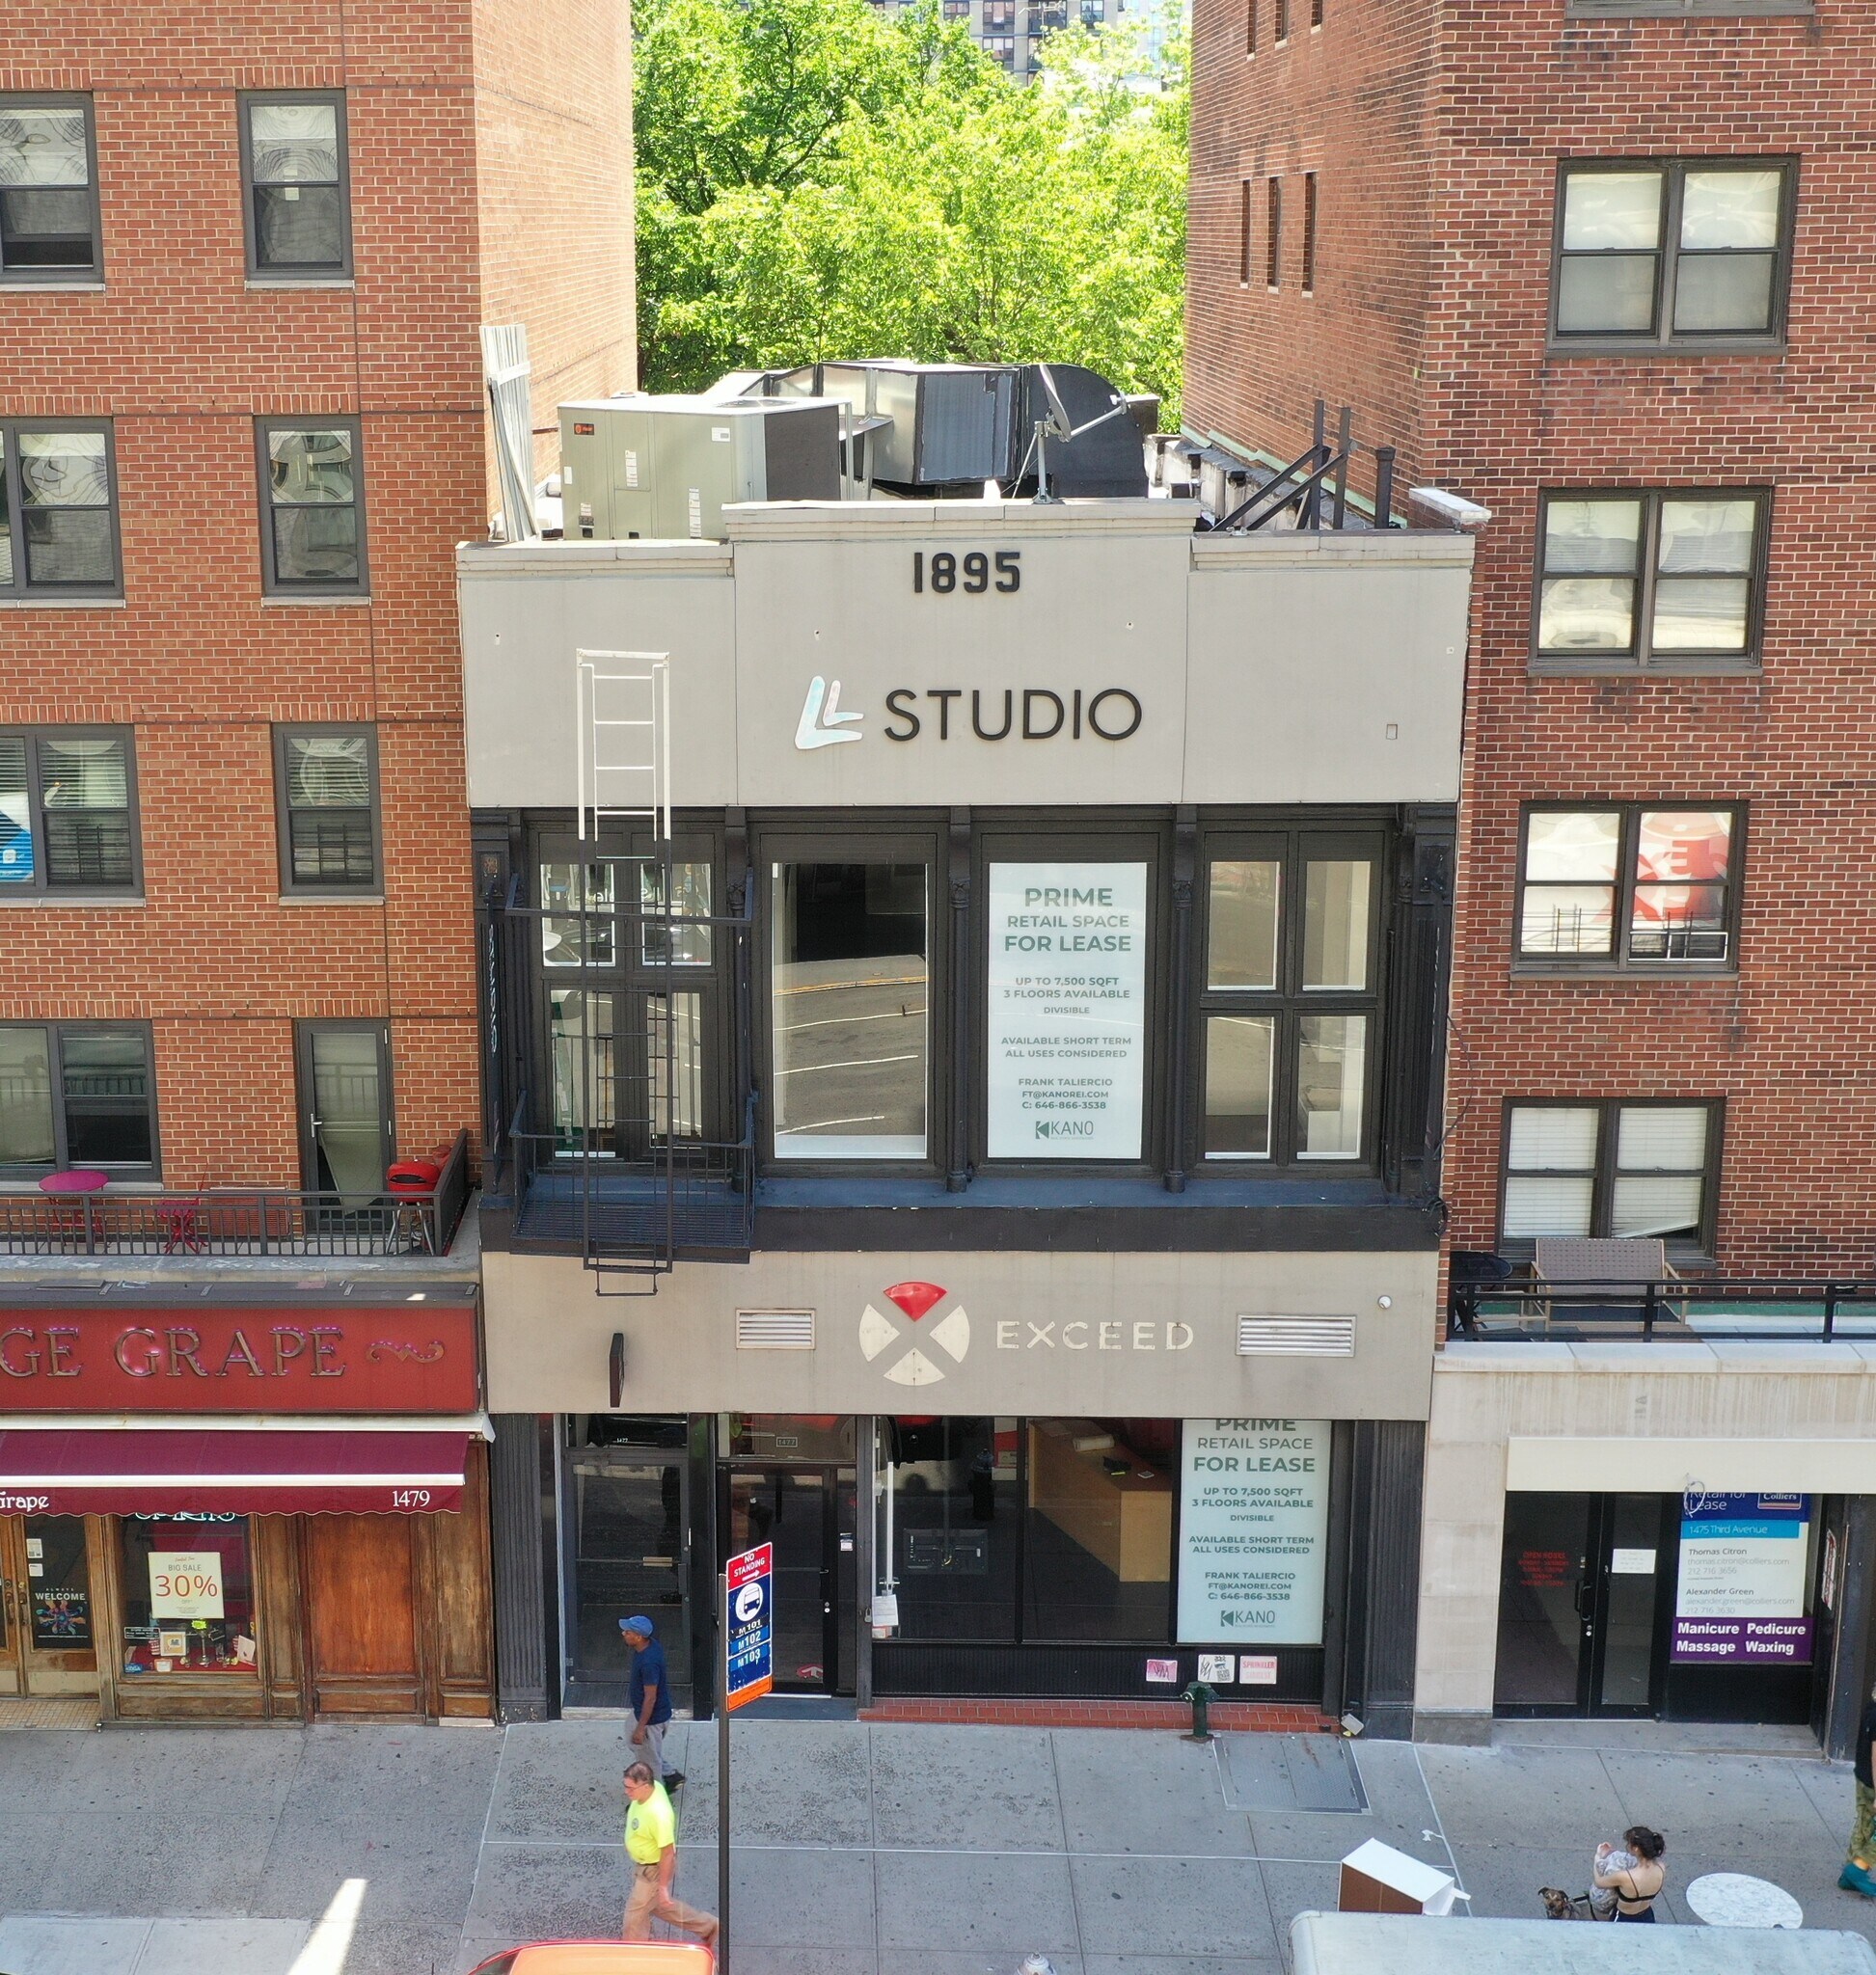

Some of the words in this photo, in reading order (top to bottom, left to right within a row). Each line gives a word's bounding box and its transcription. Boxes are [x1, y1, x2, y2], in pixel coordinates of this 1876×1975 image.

[913, 552, 1021, 593] 1895
[884, 688, 1142, 742] STUDIO
[1024, 887, 1113, 907] PRIME
[1007, 915, 1068, 928] RETAIL
[1073, 915, 1129, 928] SPACE
[1004, 935, 1052, 952] FOR
[1059, 935, 1131, 952] LEASE
[1016, 977, 1032, 986] UP
[1035, 977, 1051, 986] TO
[1054, 977, 1085, 988] 7,500
[1088, 977, 1119, 988] SQFT
[1003, 989, 1011, 998] 3
[1014, 989, 1061, 998] FLOORS
[1064, 989, 1130, 998] AVAILABLE
[1005, 1049, 1025, 1058] ALL
[1028, 1049, 1055, 1058] USES
[1058, 1049, 1128, 1058] CONSIDERED
[1022, 1091, 1109, 1099] FT@KANOREI.COM
[1021, 1101, 1032, 1110] C:
[1035, 1101, 1106, 1110] 646-866-3538
[1050, 1121, 1095, 1136] KANO
[996, 1321, 1194, 1350] EXCEED
[0, 1327, 83, 1377] GE
[115, 1327, 345, 1377] GRAPE
[1215, 1420, 1296, 1431] PRIME
[1197, 1437, 1254, 1449] RETAIL
[1259, 1438, 1314, 1449] SPACE
[1193, 1456, 1239, 1472] FOR
[1246, 1457, 1316, 1473] LEASE
[392, 1490, 430, 1507] 1479
[1240, 1488, 1271, 1497] 7,500
[1273, 1488, 1303, 1498] SQFT
[1192, 1499, 1199, 1507] 3
[1202, 1499, 1247, 1507] FLOORS
[1249, 1500, 1314, 1508] AVAILABLE
[1690, 1500, 1727, 1510] Lease
[1690, 1525, 1710, 1534] 1475
[1710, 1525, 1730, 1533] Third
[1731, 1525, 1768, 1533] Avenue
[1248, 1535, 1284, 1544] SHORT
[1242, 1546, 1310, 1555] CONSIDERED
[744, 1553, 755, 1564] NO
[734, 1557, 766, 1578] STANDING
[155, 1575, 218, 1597] 30%
[35, 1592, 86, 1601] WELCOME
[1220, 1592, 1291, 1601] 646-866-3538
[1235, 1610, 1276, 1624] KANO
[738, 1619, 762, 1635] M101
[1678, 1622, 1740, 1634] Manicure
[1747, 1623, 1806, 1635] Pedicure
[738, 1631, 762, 1650] M102
[1676, 1640, 1736, 1655] Massage
[1746, 1641, 1794, 1655] Waxing
[737, 1648, 761, 1668] M103
